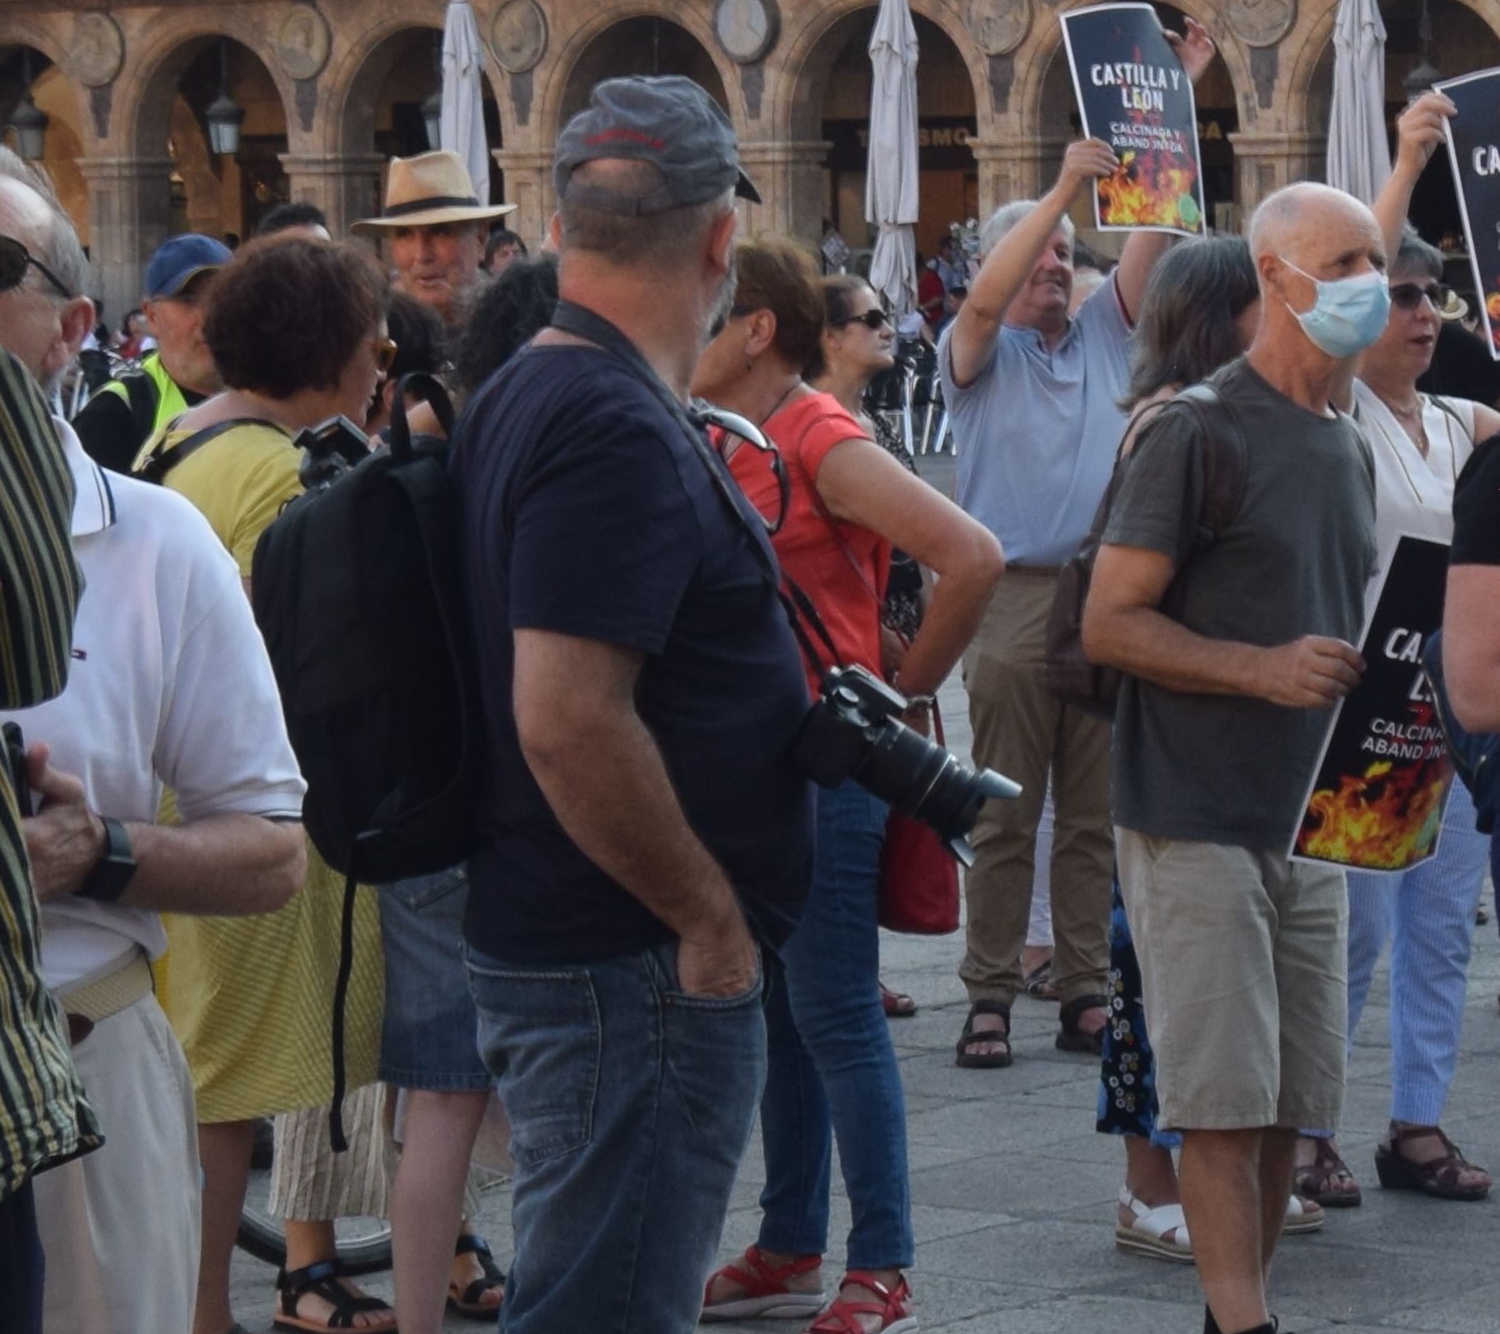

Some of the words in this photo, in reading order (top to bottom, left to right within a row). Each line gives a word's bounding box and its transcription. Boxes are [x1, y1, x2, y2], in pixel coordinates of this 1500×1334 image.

[1091, 63, 1168, 91] CASTILLA
[1170, 67, 1181, 91] Y
[1121, 86, 1164, 112] LEÓN
[857, 126, 970, 149] TSMO
[1371, 717, 1444, 741] CALCINA
